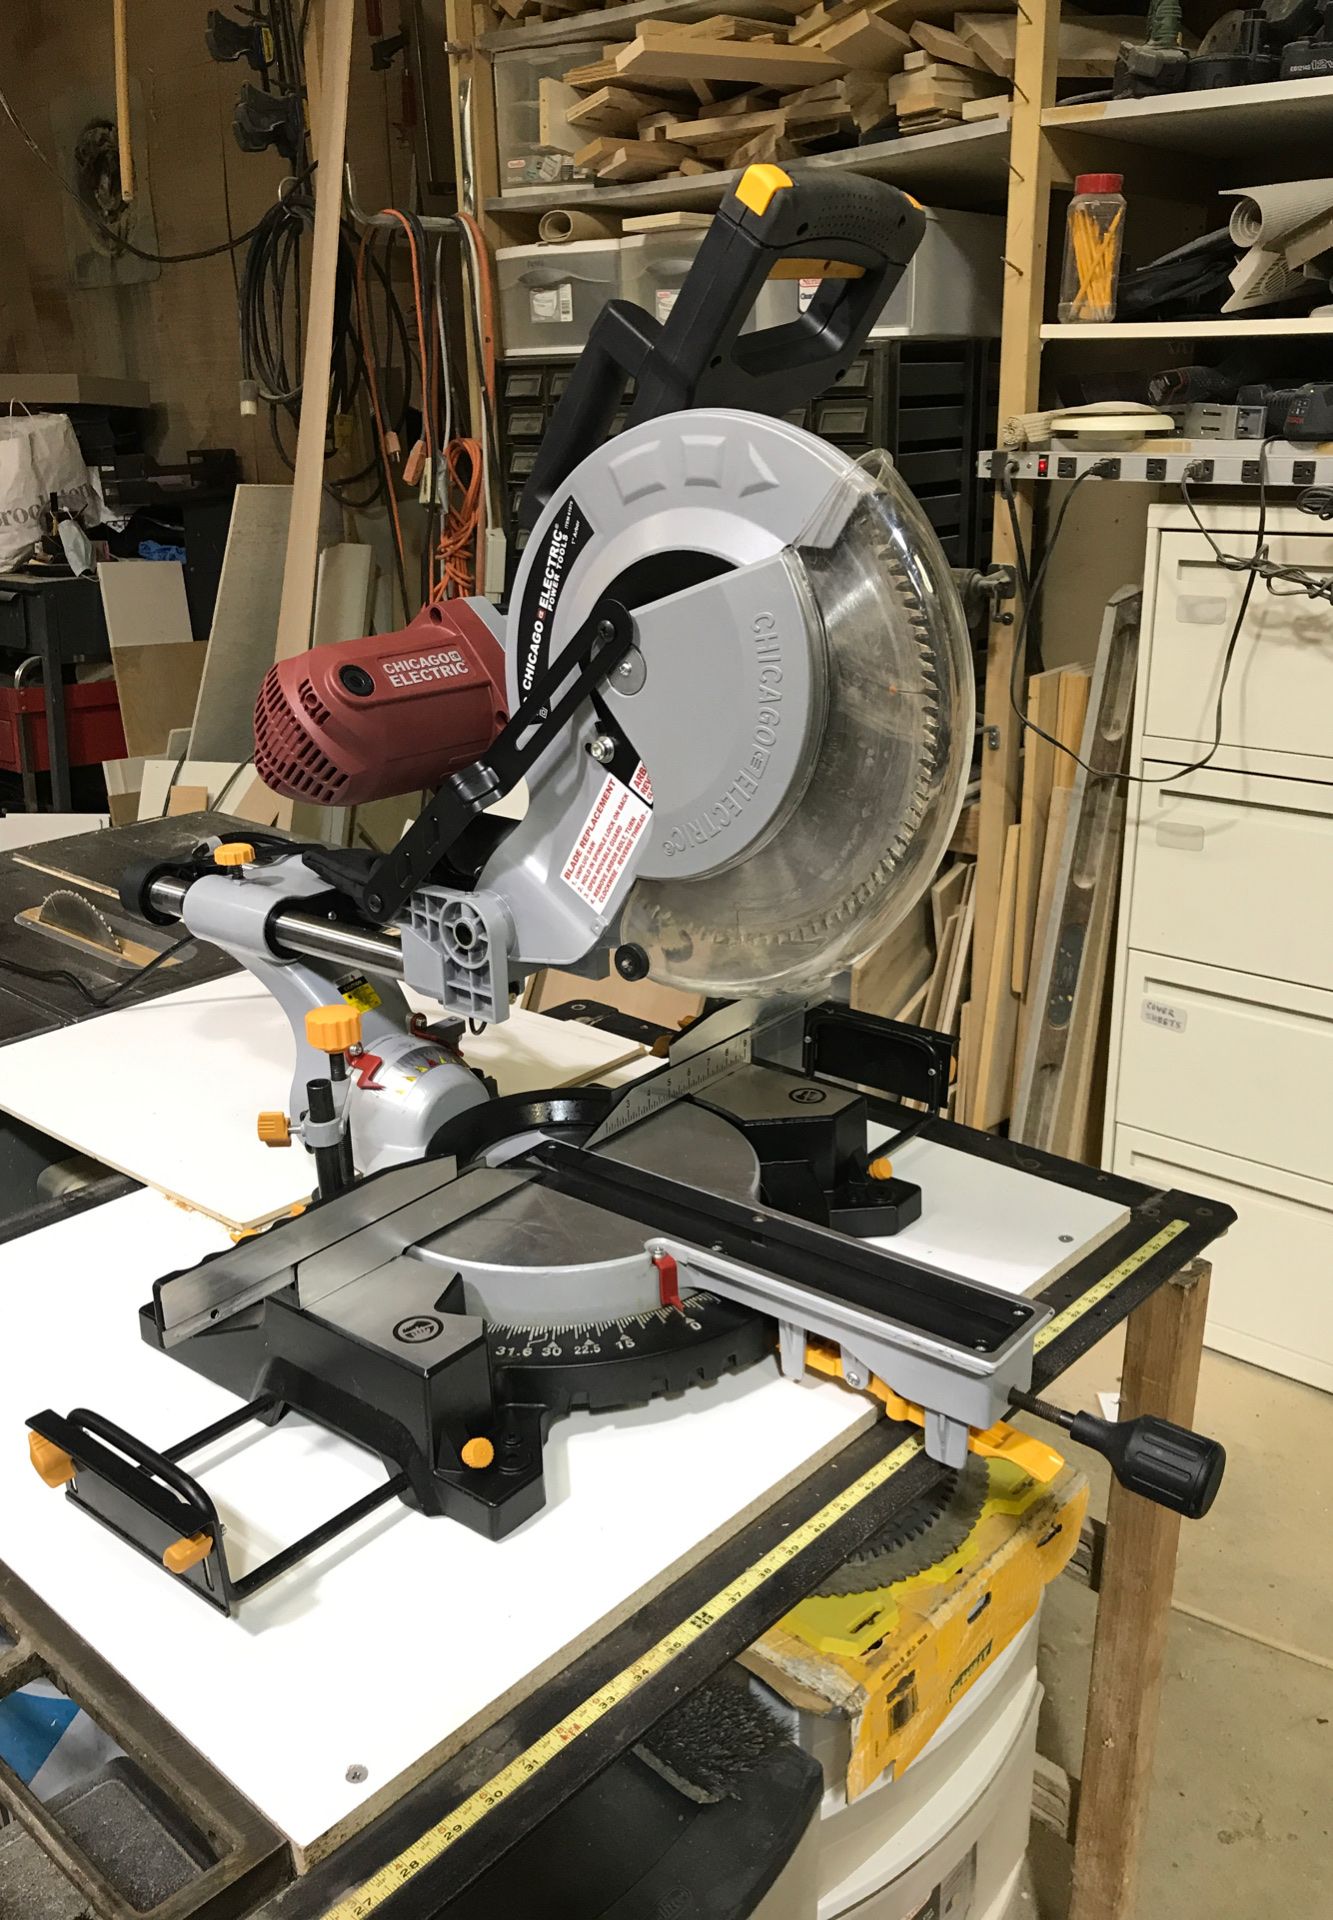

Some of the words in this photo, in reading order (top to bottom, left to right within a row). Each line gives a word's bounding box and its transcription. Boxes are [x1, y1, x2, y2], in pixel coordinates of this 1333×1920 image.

[522, 620, 544, 691] CHICAGO
[539, 529, 563, 609] ELECTRIC
[548, 571, 561, 612] POWER
[556, 534, 568, 570] TOOLS
[382, 653, 450, 675] CHICAGO
[389, 662, 469, 688] ELECTRIC
[752, 611, 783, 747] CHICAGO
[564, 849, 582, 880] BLADE
[579, 778, 616, 848] REPLACEMENT
[581, 869, 591, 886] HOLD
[592, 837, 606, 862] SPINDLE
[604, 820, 615, 837] LOCK
[612, 809, 620, 820] ON
[618, 793, 628, 811] BACK
[617, 839, 633, 866] REVERSE
[631, 814, 646, 839] THREAD
[672, 769, 759, 853] ELECTRIC
[574, 855, 589, 880] UNPLUG
[587, 841, 595, 855] SAW
[587, 874, 597, 892] OPEN
[609, 825, 622, 847] GUARD
[593, 873, 607, 898] REMOVE
[606, 852, 618, 873] ARBOR
[625, 817, 636, 834] TURN
[495, 1346, 533, 1357] 31.6
[541, 1346, 562, 1357] 30
[574, 1344, 601, 1355] 22.5
[616, 1340, 636, 1350] 15
[690, 1322, 702, 1330] 0
[353, 1897, 372, 1916] 27
[400, 1860, 420, 1878] 28
[444, 1824, 463, 1841] 29
[485, 1790, 503, 1806] 30
[524, 1759, 539, 1772] 31
[599, 1696, 616, 1709] 33
[634, 1669, 649, 1682] 34
[728, 1591, 743, 1604] 37
[758, 1568, 772, 1579] 38
[786, 1545, 799, 1557] 39
[813, 1522, 826, 1533] 40
